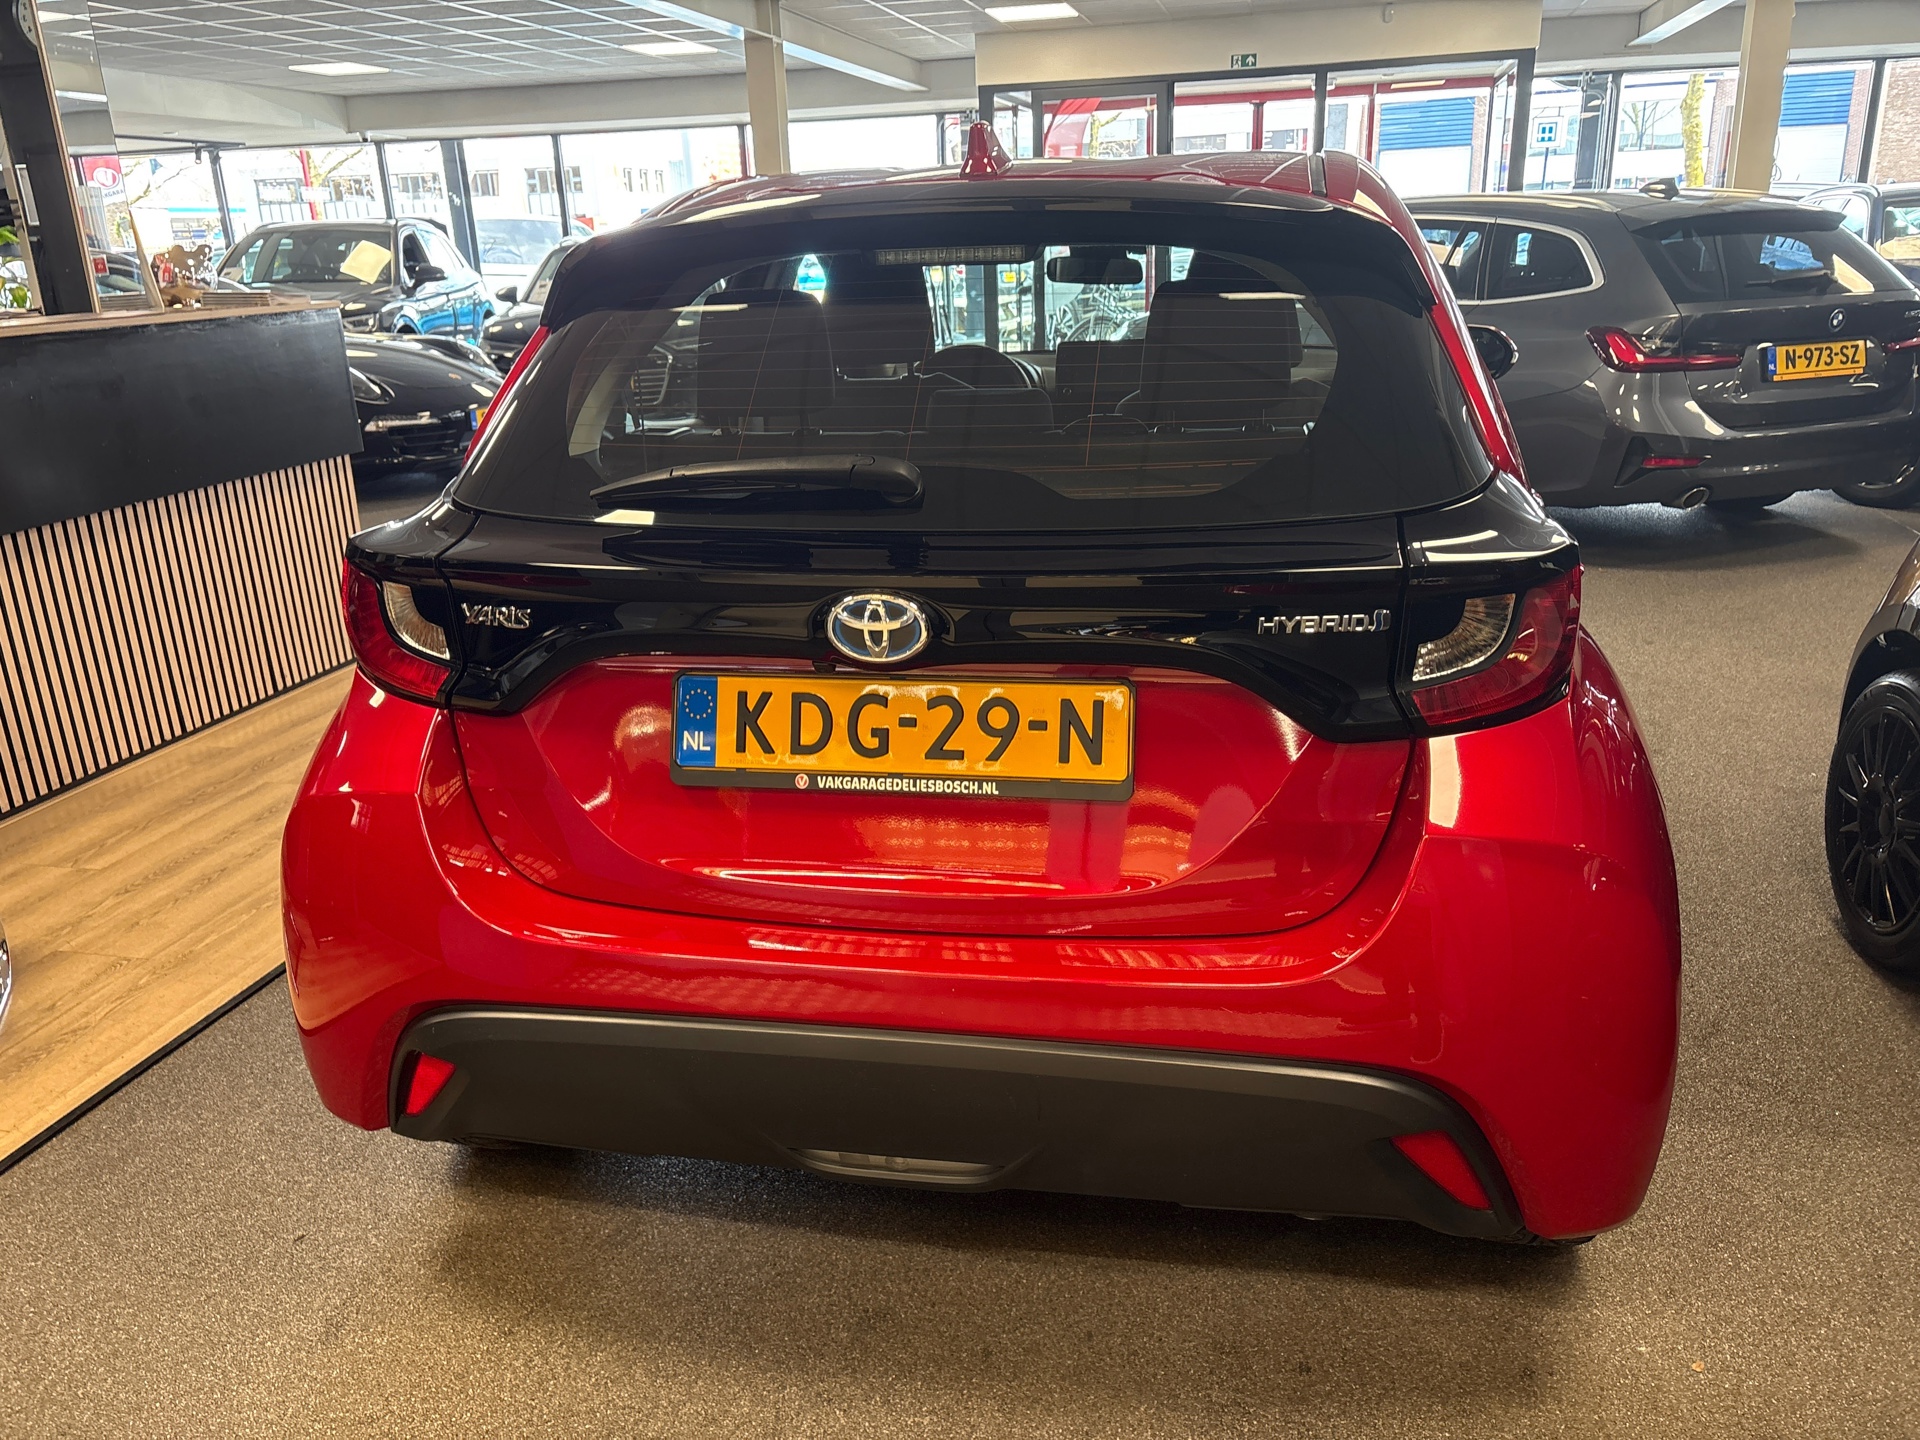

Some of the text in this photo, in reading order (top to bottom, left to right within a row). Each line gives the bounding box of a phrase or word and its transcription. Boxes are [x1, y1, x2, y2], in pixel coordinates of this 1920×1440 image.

[102, 189, 125, 198] KGARA
[1768, 363, 1776, 371] NL
[1785, 344, 1860, 370] N-973-SZ
[460, 602, 532, 629] YARIS
[1257, 613, 1370, 635] HYBRID
[734, 690, 1104, 766] KDG-29-N
[682, 730, 711, 752] NL
[816, 775, 999, 795] VAKGARAGEDELIESBOSCH.NL
